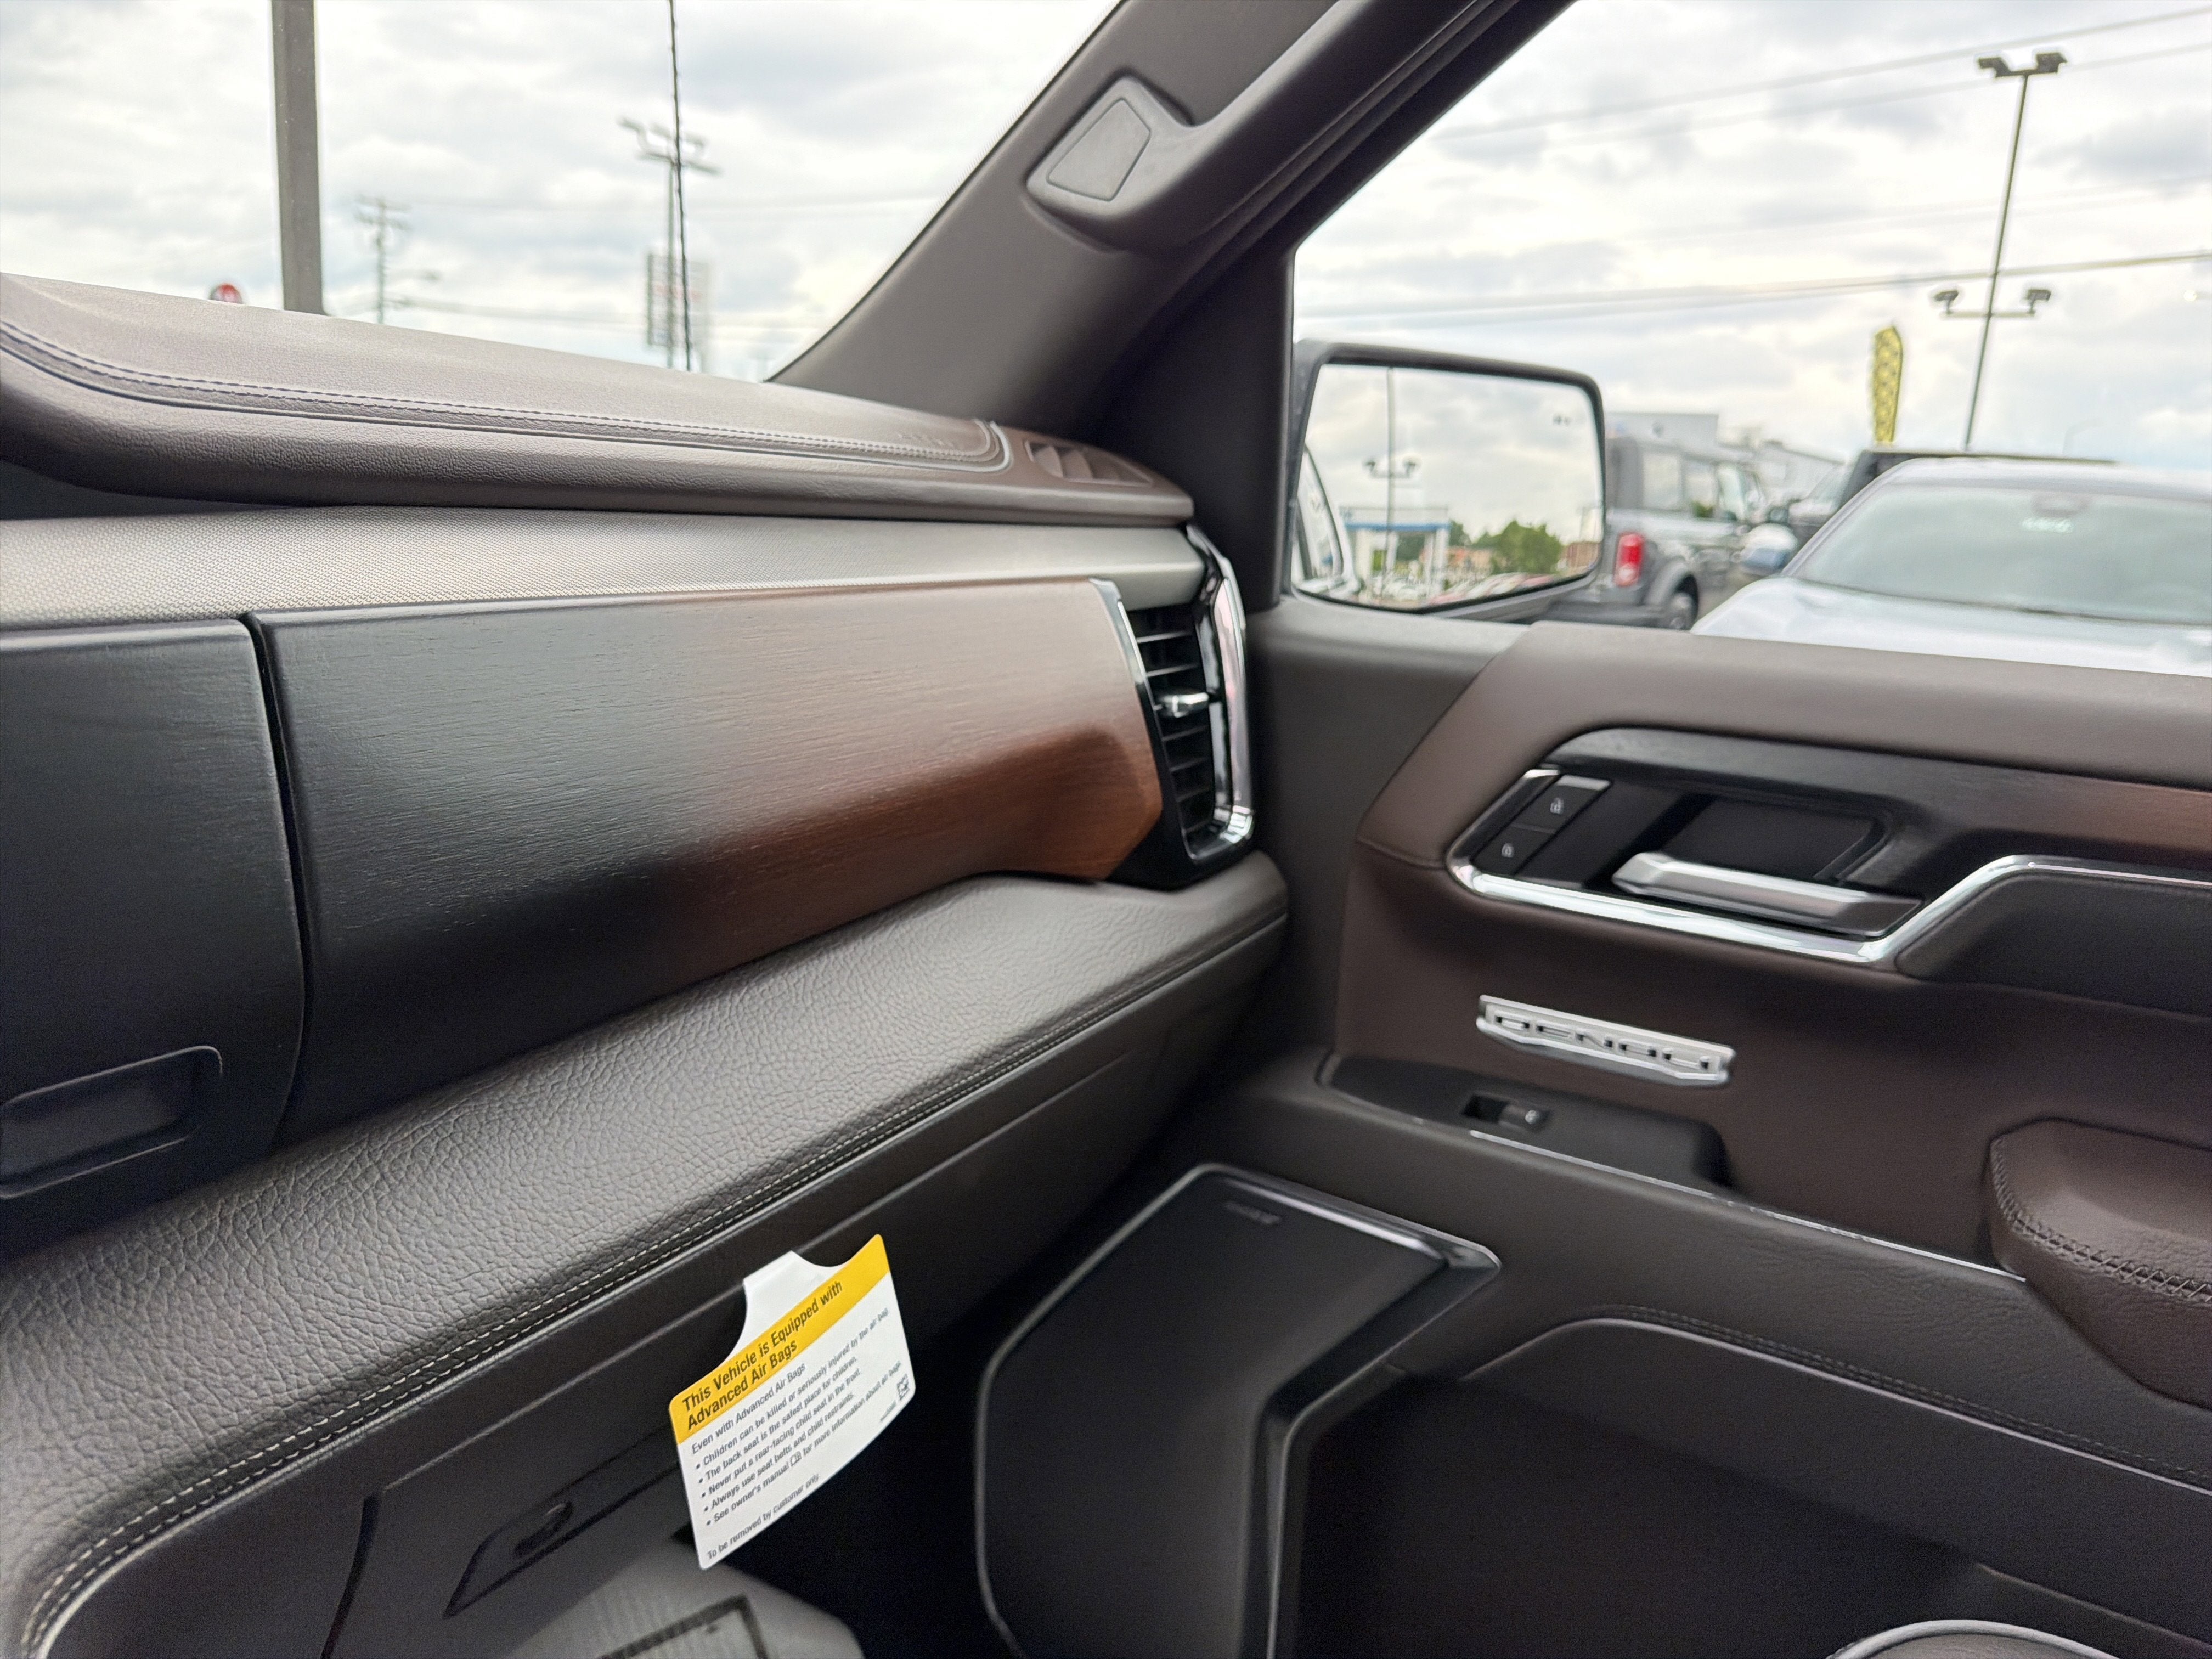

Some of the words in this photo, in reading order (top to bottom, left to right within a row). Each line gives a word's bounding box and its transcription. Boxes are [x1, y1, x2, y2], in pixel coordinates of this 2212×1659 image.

[682, 1386, 711, 1411] This
[713, 1351, 757, 1390] Vehicle
[758, 1341, 769, 1357] is
[771, 1297, 819, 1347] Equipped
[820, 1281, 842, 1306] with
[688, 1378, 748, 1430] Advanced
[752, 1363, 766, 1384] Air
[769, 1340, 797, 1368] Bags
[703, 1437, 737, 1465] Children
[740, 1426, 754, 1439] can
[755, 1416, 765, 1426] be
[766, 1397, 787, 1419] killed
[788, 1391, 795, 1402] or
[798, 1364, 827, 1395] seriously
[828, 1343, 850, 1368] injured
[851, 1338, 858, 1347] by
[859, 1328, 868, 1339] the
[691, 1435, 713, 1454] Even
[715, 1420, 733, 1437] with
[736, 1386, 774, 1423] Advanced
[776, 1378, 785, 1392] Air
[787, 1363, 805, 1382] Bags
[706, 1468, 721, 1480] The
[723, 1452, 742, 1469] back
[743, 1437, 759, 1453] seat
[761, 1431, 768, 1441] is
[769, 1421, 781, 1435] the
[782, 1402, 803, 1424] safest
[804, 1387, 822, 1408] place
[822, 1379, 831, 1391] for
[709, 1474, 732, 1494] Never
[734, 1464, 747, 1480] put
[755, 1426, 795, 1464] rear-facing
[795, 1410, 812, 1430] child
[813, 1399, 827, 1415] seat
[828, 1393, 834, 1402] in
[835, 1383, 845, 1396] the
[714, 1508, 729, 1522] See
[731, 1484, 761, 1509] owner's
[763, 1461, 789, 1489] manual
[803, 1444, 812, 1457] for
[814, 1429, 831, 1447] more
[832, 1398, 865, 1432] information
[866, 1381, 881, 1401] about
[711, 1485, 740, 1509] Always
[742, 1474, 755, 1488] use
[757, 1462, 773, 1476] seat
[775, 1444, 792, 1463] belts
[793, 1431, 806, 1448] and
[808, 1417, 823, 1436] child
[707, 1550, 717, 1559] To
[718, 1542, 728, 1552] be
[730, 1517, 761, 1544] removed
[763, 1511, 771, 1523] by
[773, 1484, 804, 1513] customer
